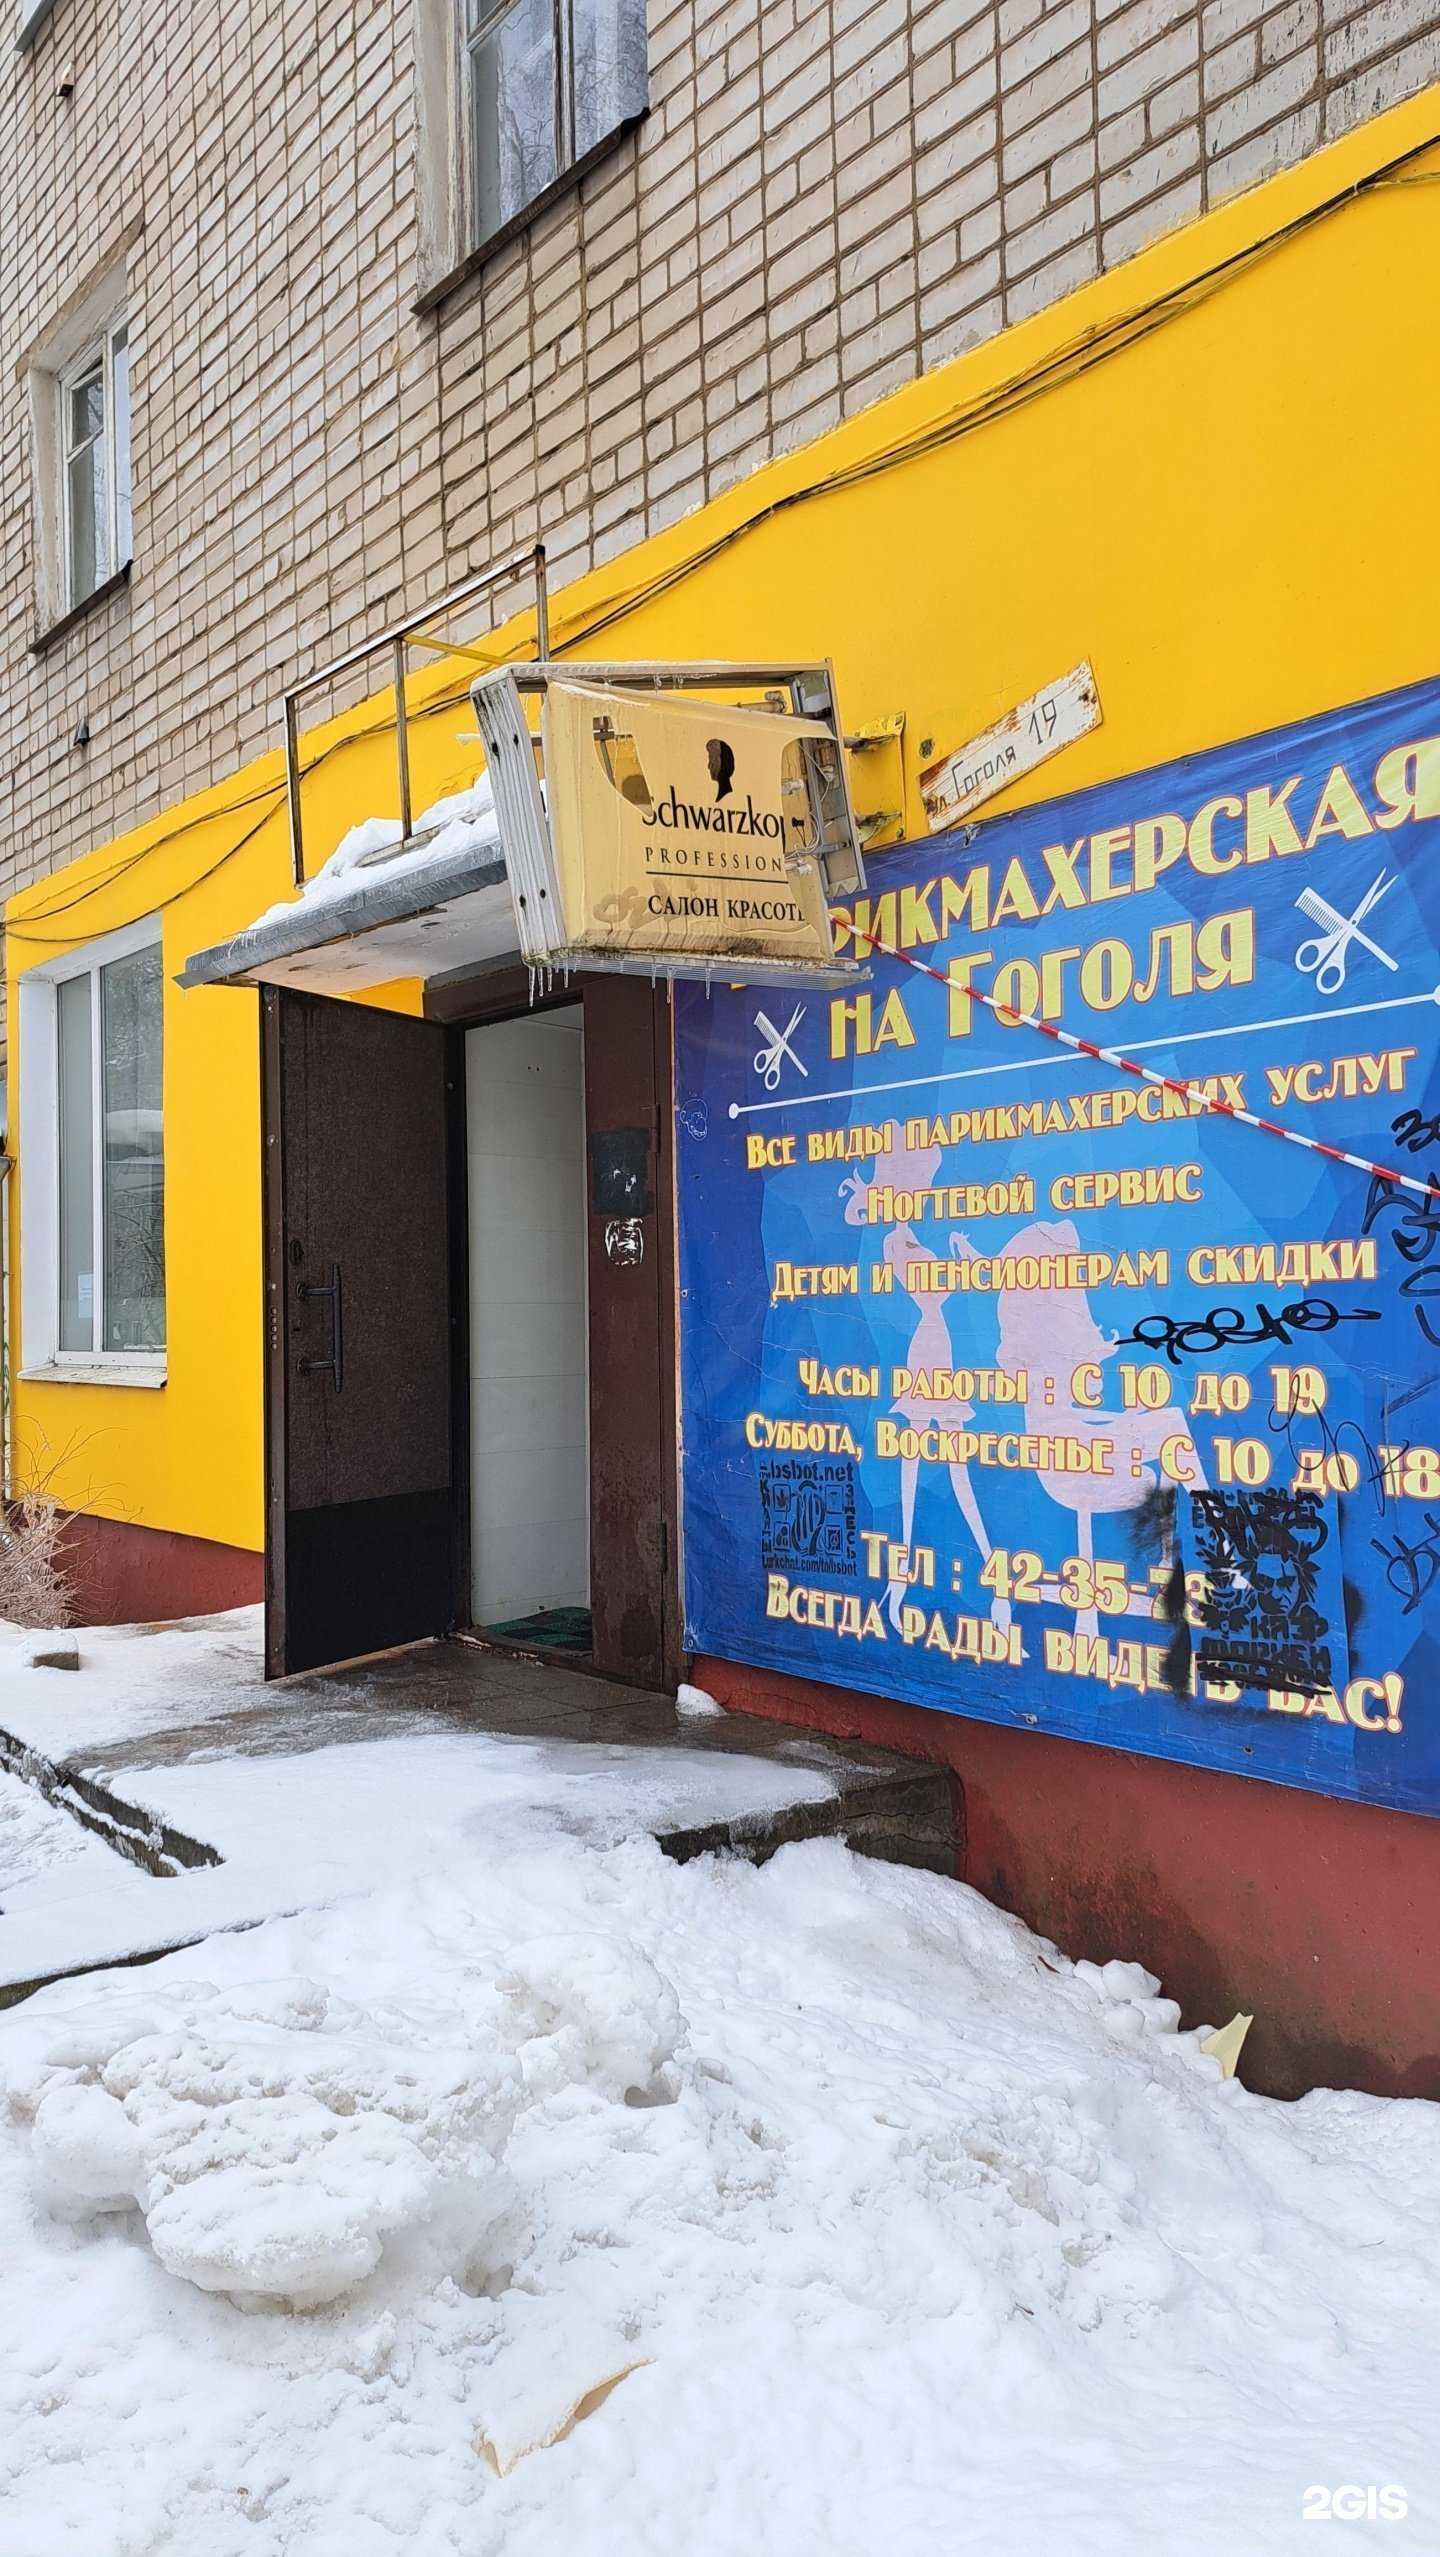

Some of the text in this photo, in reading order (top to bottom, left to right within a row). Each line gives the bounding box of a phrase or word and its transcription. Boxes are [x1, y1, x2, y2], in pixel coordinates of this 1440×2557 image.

[951, 745, 1017, 800] Гоголя
[1028, 698, 1057, 745] 19
[645, 846, 782, 872] PROFESSION
[647, 895, 719, 917] САЛОН
[1119, 1364, 1171, 1410] 10
[1271, 1366, 1326, 1415] 19
[1213, 1438, 1270, 1486] 10
[1378, 1446, 1440, 1500] 18
